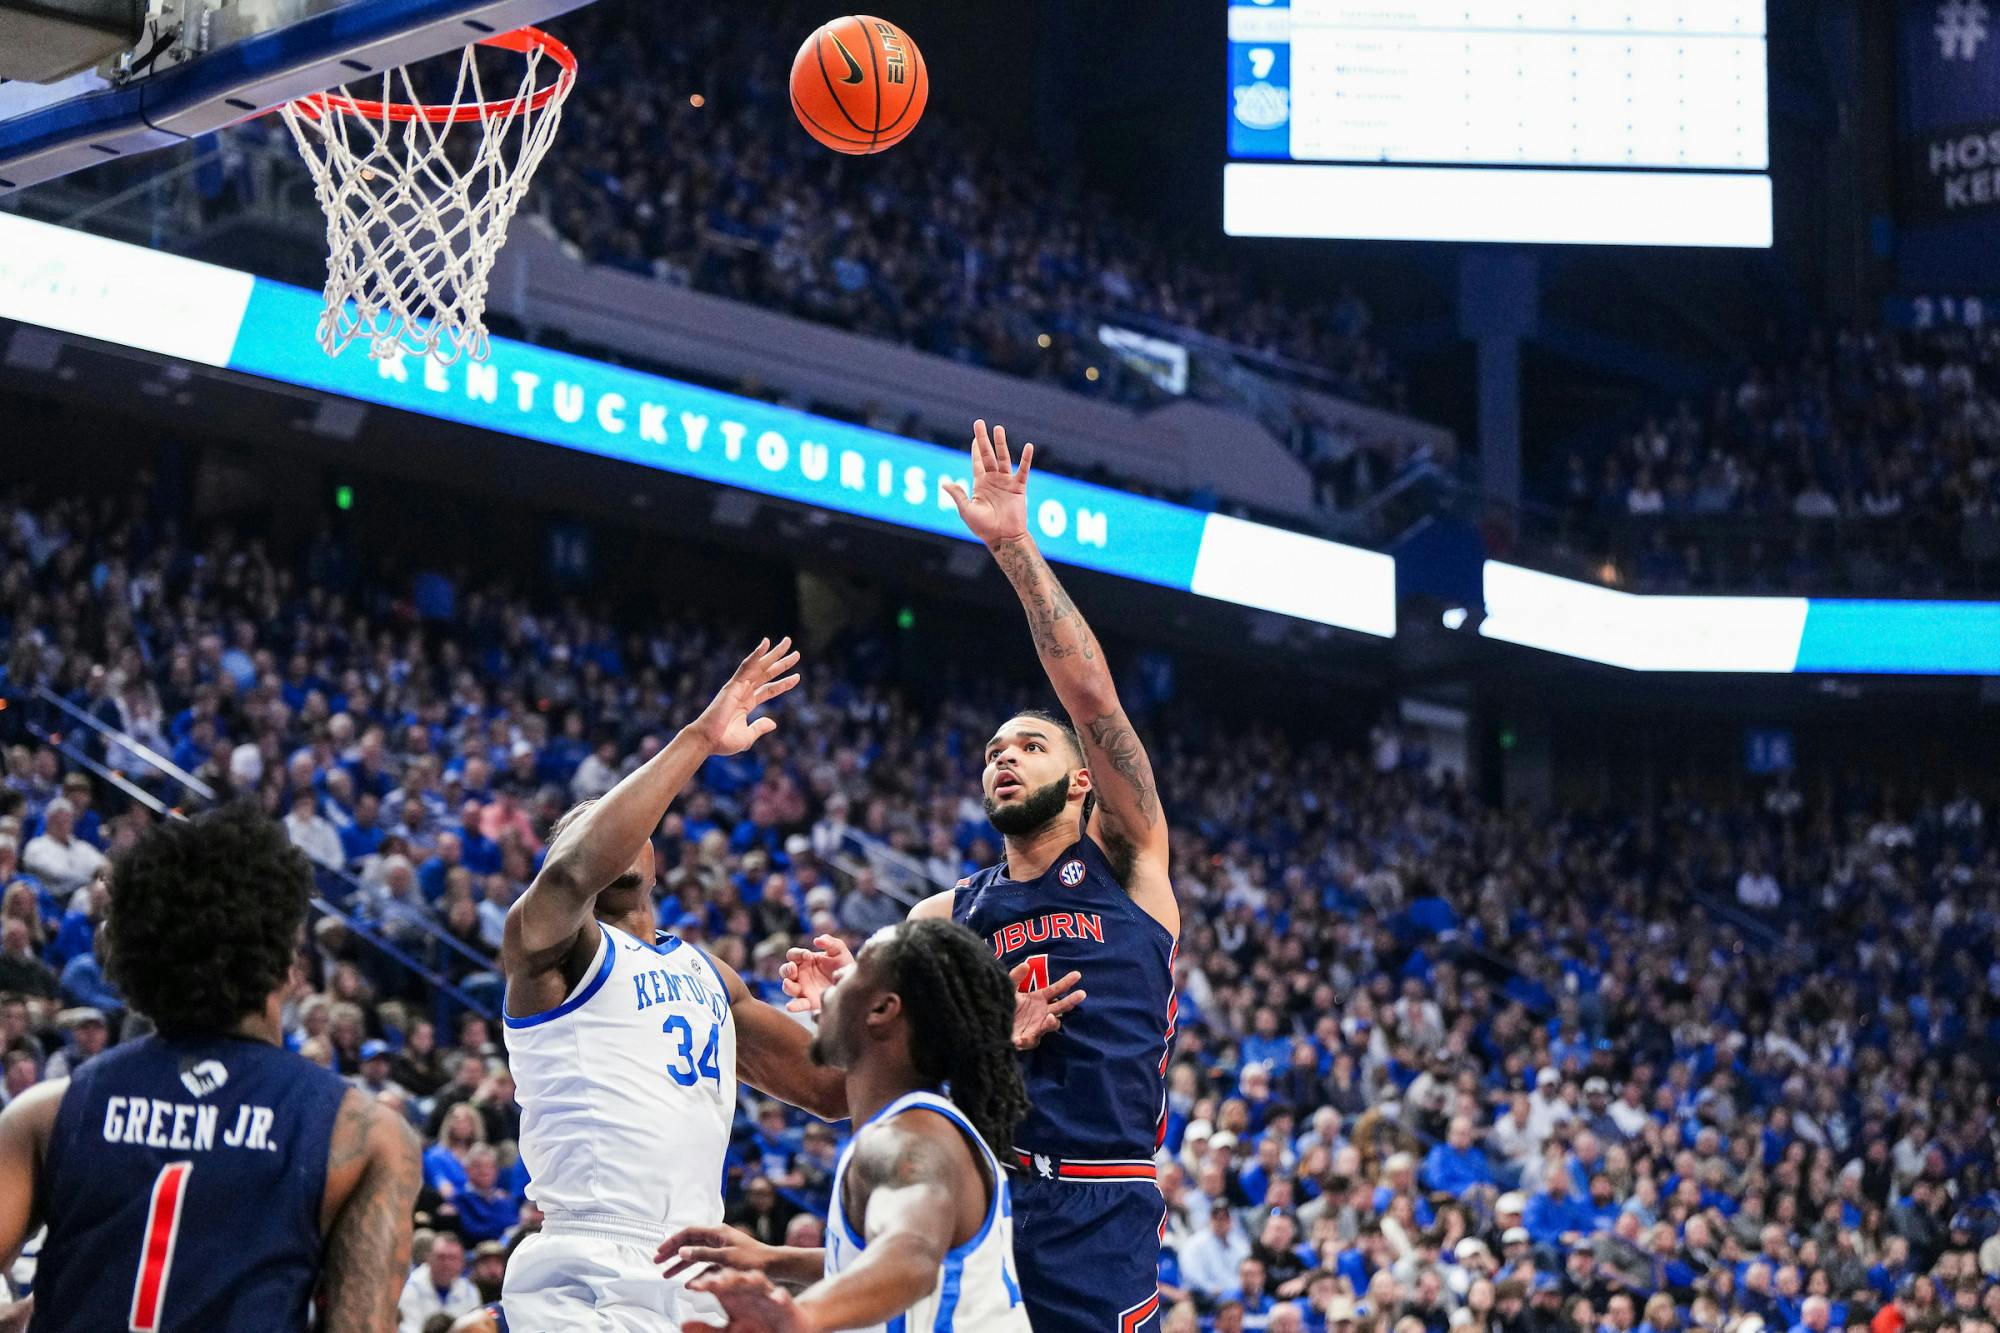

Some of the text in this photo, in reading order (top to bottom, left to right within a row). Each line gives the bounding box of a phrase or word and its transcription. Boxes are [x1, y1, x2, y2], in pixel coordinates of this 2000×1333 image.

[875, 23, 905, 84] ELITE
[1060, 860, 1084, 886] SEC
[991, 912, 1105, 960] UBURN
[662, 1014, 720, 1095] 34
[103, 1096, 278, 1152] GREEN JR.
[128, 1161, 194, 1333] 1
